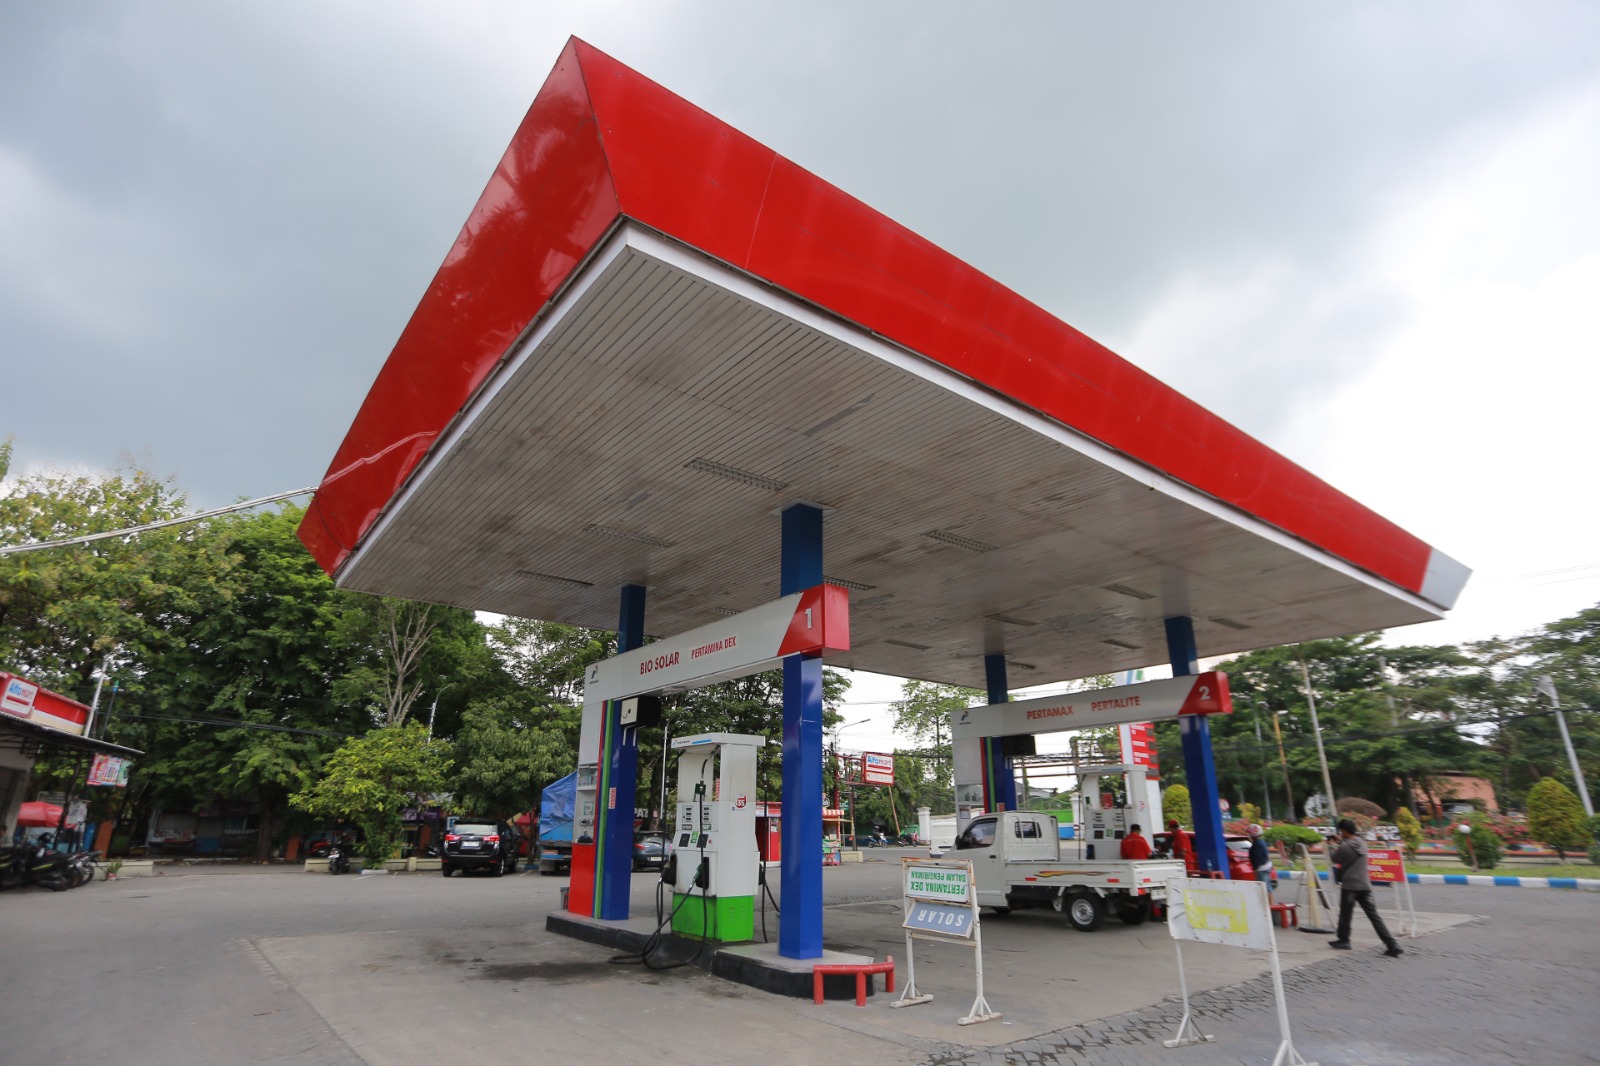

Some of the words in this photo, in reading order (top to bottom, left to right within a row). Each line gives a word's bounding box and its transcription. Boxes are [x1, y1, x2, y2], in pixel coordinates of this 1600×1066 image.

[804, 607, 812, 629] 1
[691, 640, 723, 659] PERTAMINA
[724, 635, 737, 649] DEX
[640, 659, 653, 675] BIO
[655, 651, 680, 670] SOLAR
[1199, 685, 1212, 701] 2
[1091, 696, 1141, 711] PERTALITE
[1026, 705, 1074, 720] PERTAMAX
[867, 755, 892, 766] Alfamart
[911, 871, 944, 881] PENGIRIMAN
[946, 873, 966, 882] DALAM
[911, 881, 924, 891] DEX
[925, 882, 965, 895] PERTAMINA
[917, 909, 965, 927] SOLAR
